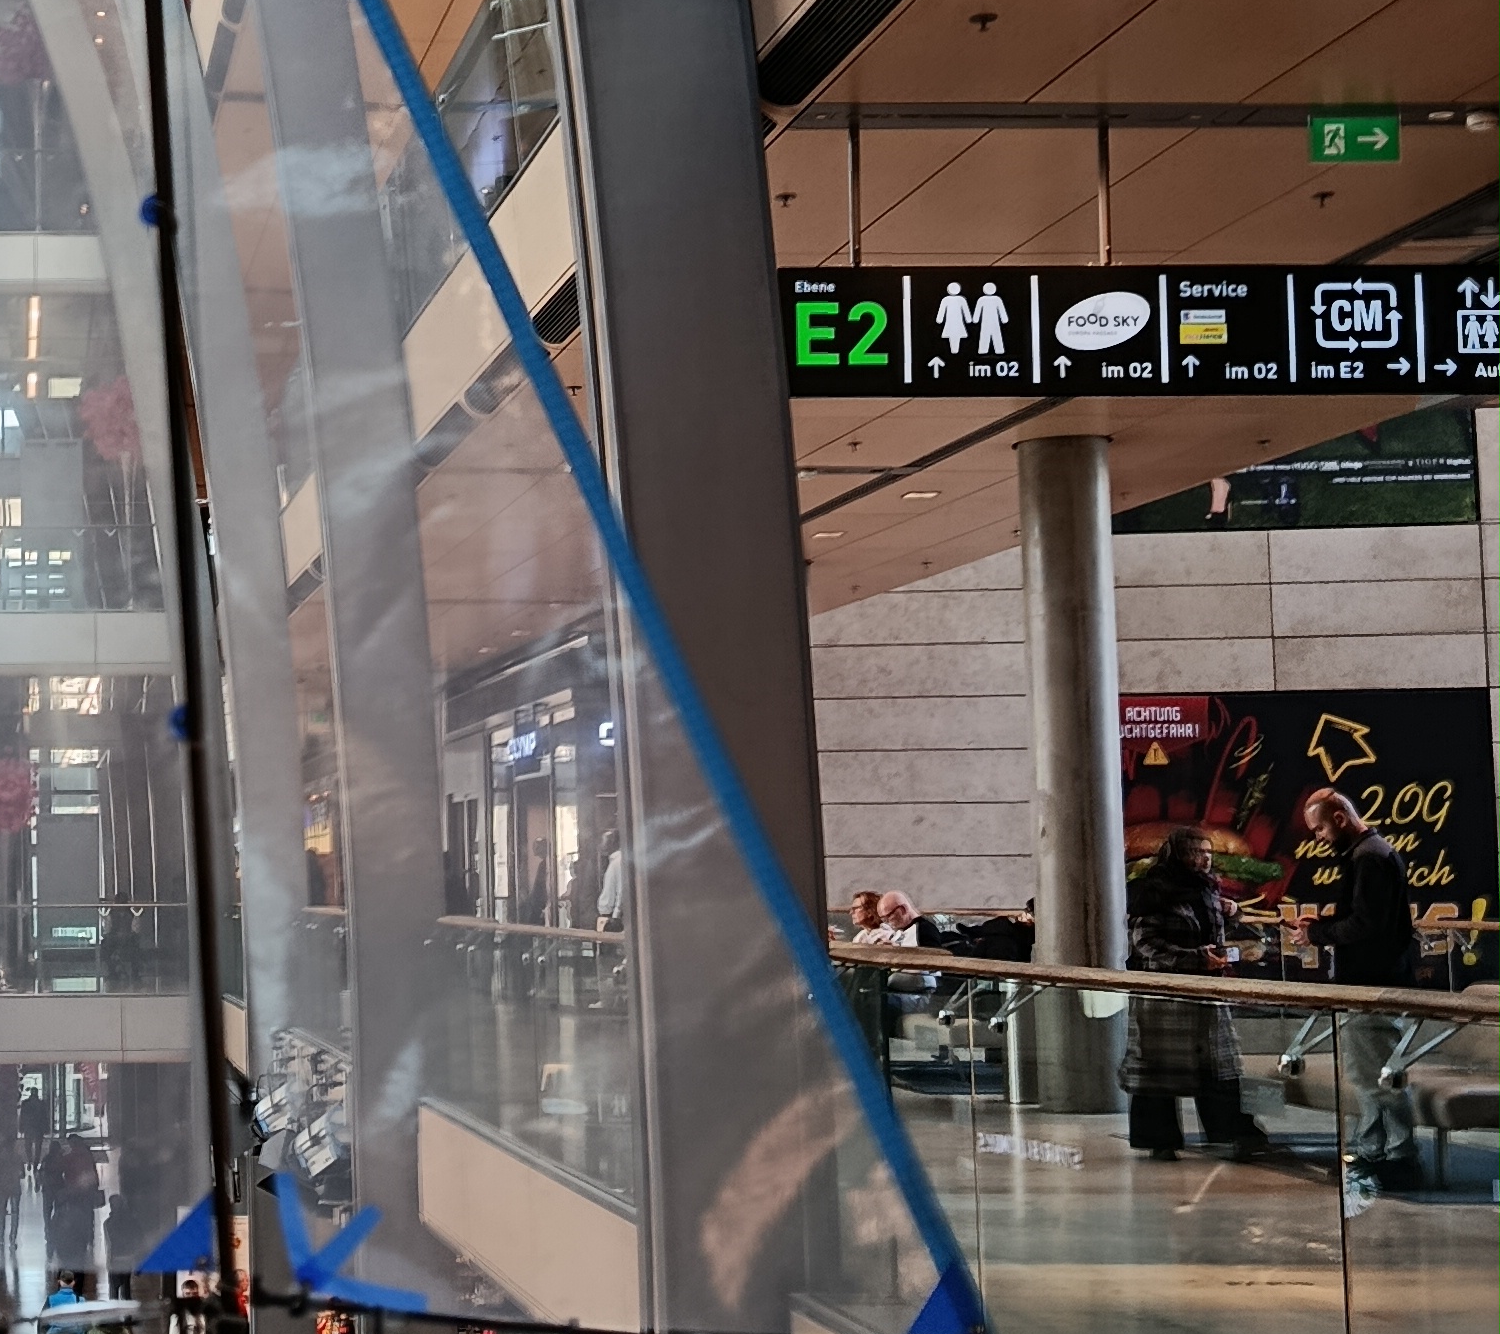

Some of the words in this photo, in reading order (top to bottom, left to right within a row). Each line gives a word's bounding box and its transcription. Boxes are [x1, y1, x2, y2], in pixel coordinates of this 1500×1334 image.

[794, 280, 836, 293] Ebene
[1179, 280, 1248, 298] Service
[1067, 313, 1109, 327] FOOD
[1113, 315, 1140, 327] SKY
[1330, 299, 1383, 332] CM
[796, 301, 889, 365] E2
[969, 362, 991, 377] im
[996, 361, 1019, 377] 02
[1102, 362, 1124, 378] im
[1129, 362, 1153, 378] 02
[1225, 362, 1248, 379] im
[1253, 362, 1278, 379] 02
[1311, 361, 1335, 378] im
[1340, 361, 1364, 378] E2
[1125, 707, 1181, 722] ACHTUNG
